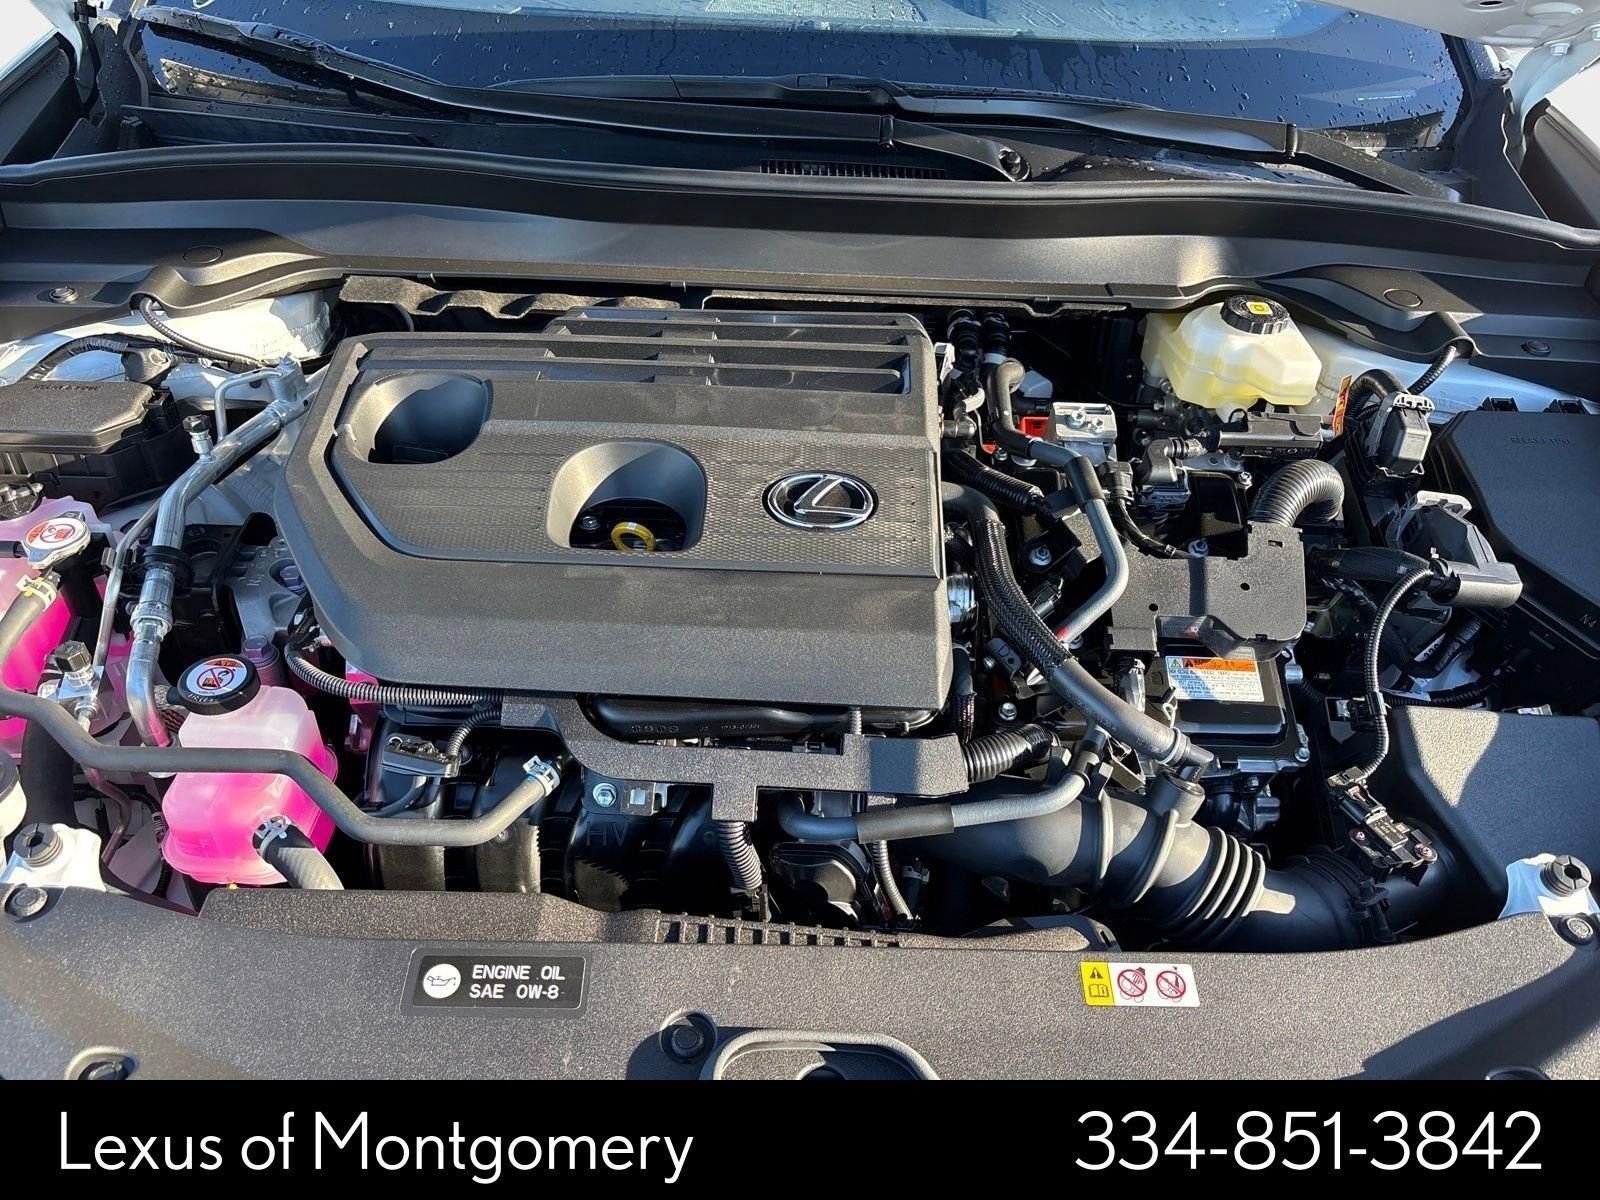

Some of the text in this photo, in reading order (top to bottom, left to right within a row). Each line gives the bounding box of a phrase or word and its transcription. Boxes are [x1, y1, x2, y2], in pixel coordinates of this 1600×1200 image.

[472, 964, 566, 980] ENGINE OIL
[469, 984, 505, 999] SAE
